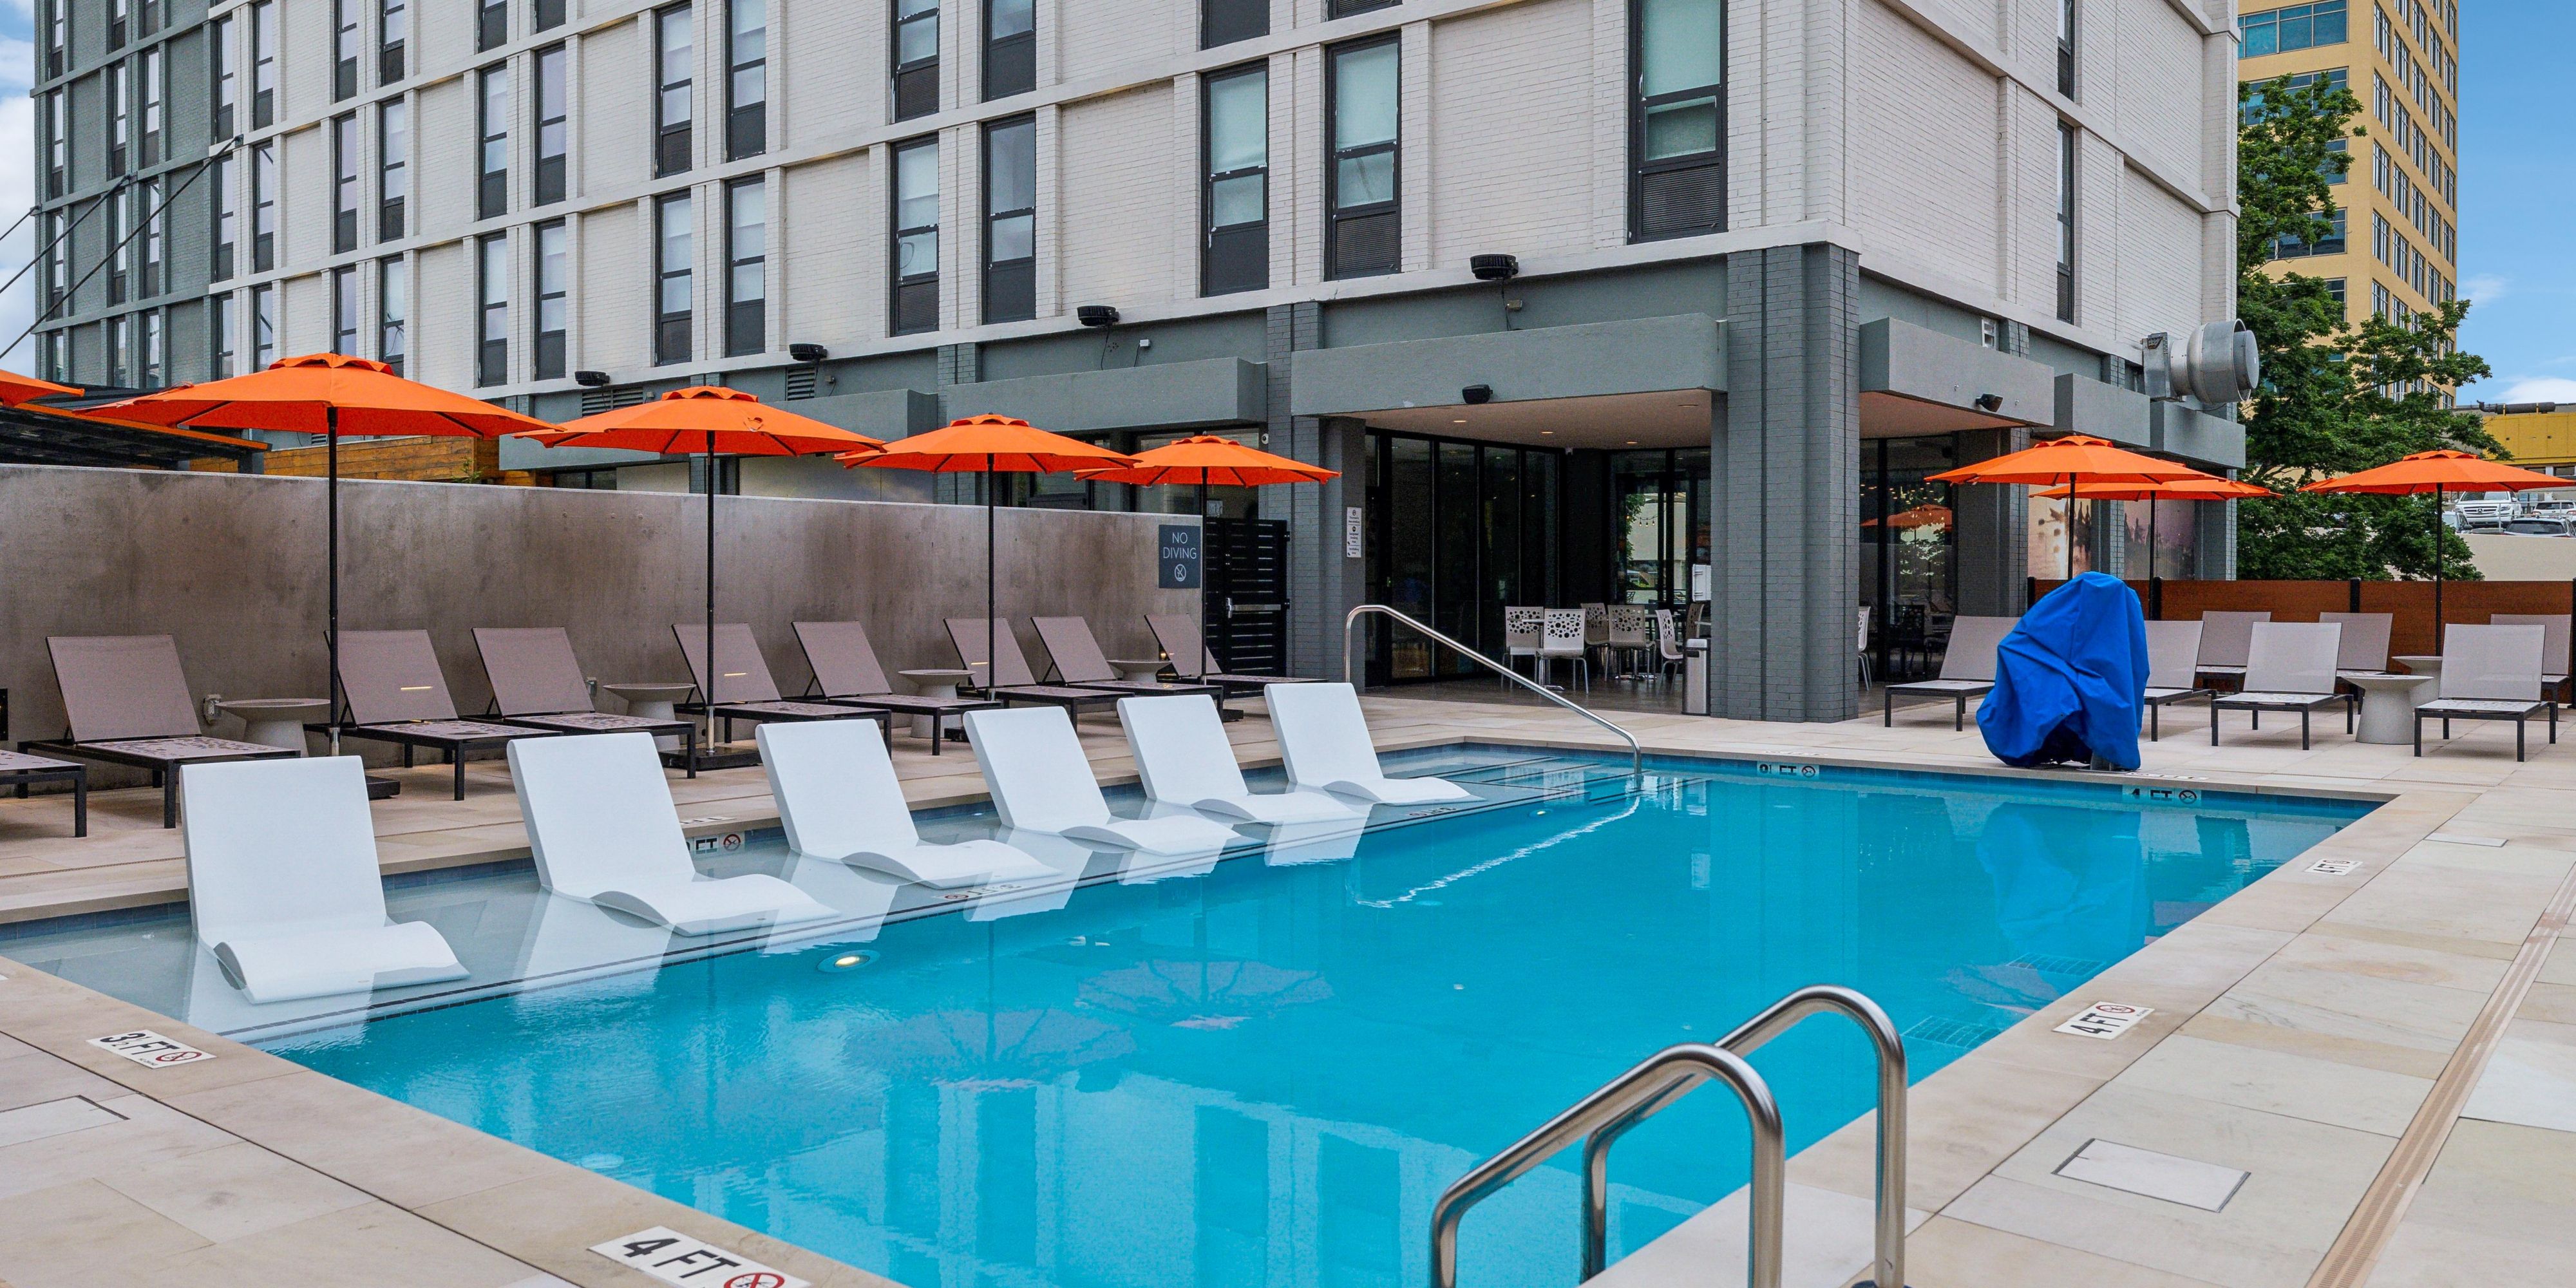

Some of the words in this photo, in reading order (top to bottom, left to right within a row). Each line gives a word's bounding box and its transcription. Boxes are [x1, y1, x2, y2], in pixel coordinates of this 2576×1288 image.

[1172, 532, 1188, 544] NO
[1163, 547, 1197, 559] DIVING
[2079, 1012, 2128, 1027] FT
[2070, 1025, 2112, 1034] 4
[118, 1041, 180, 1055] FT
[623, 1238, 679, 1258] 4
[652, 1249, 741, 1278] FT
